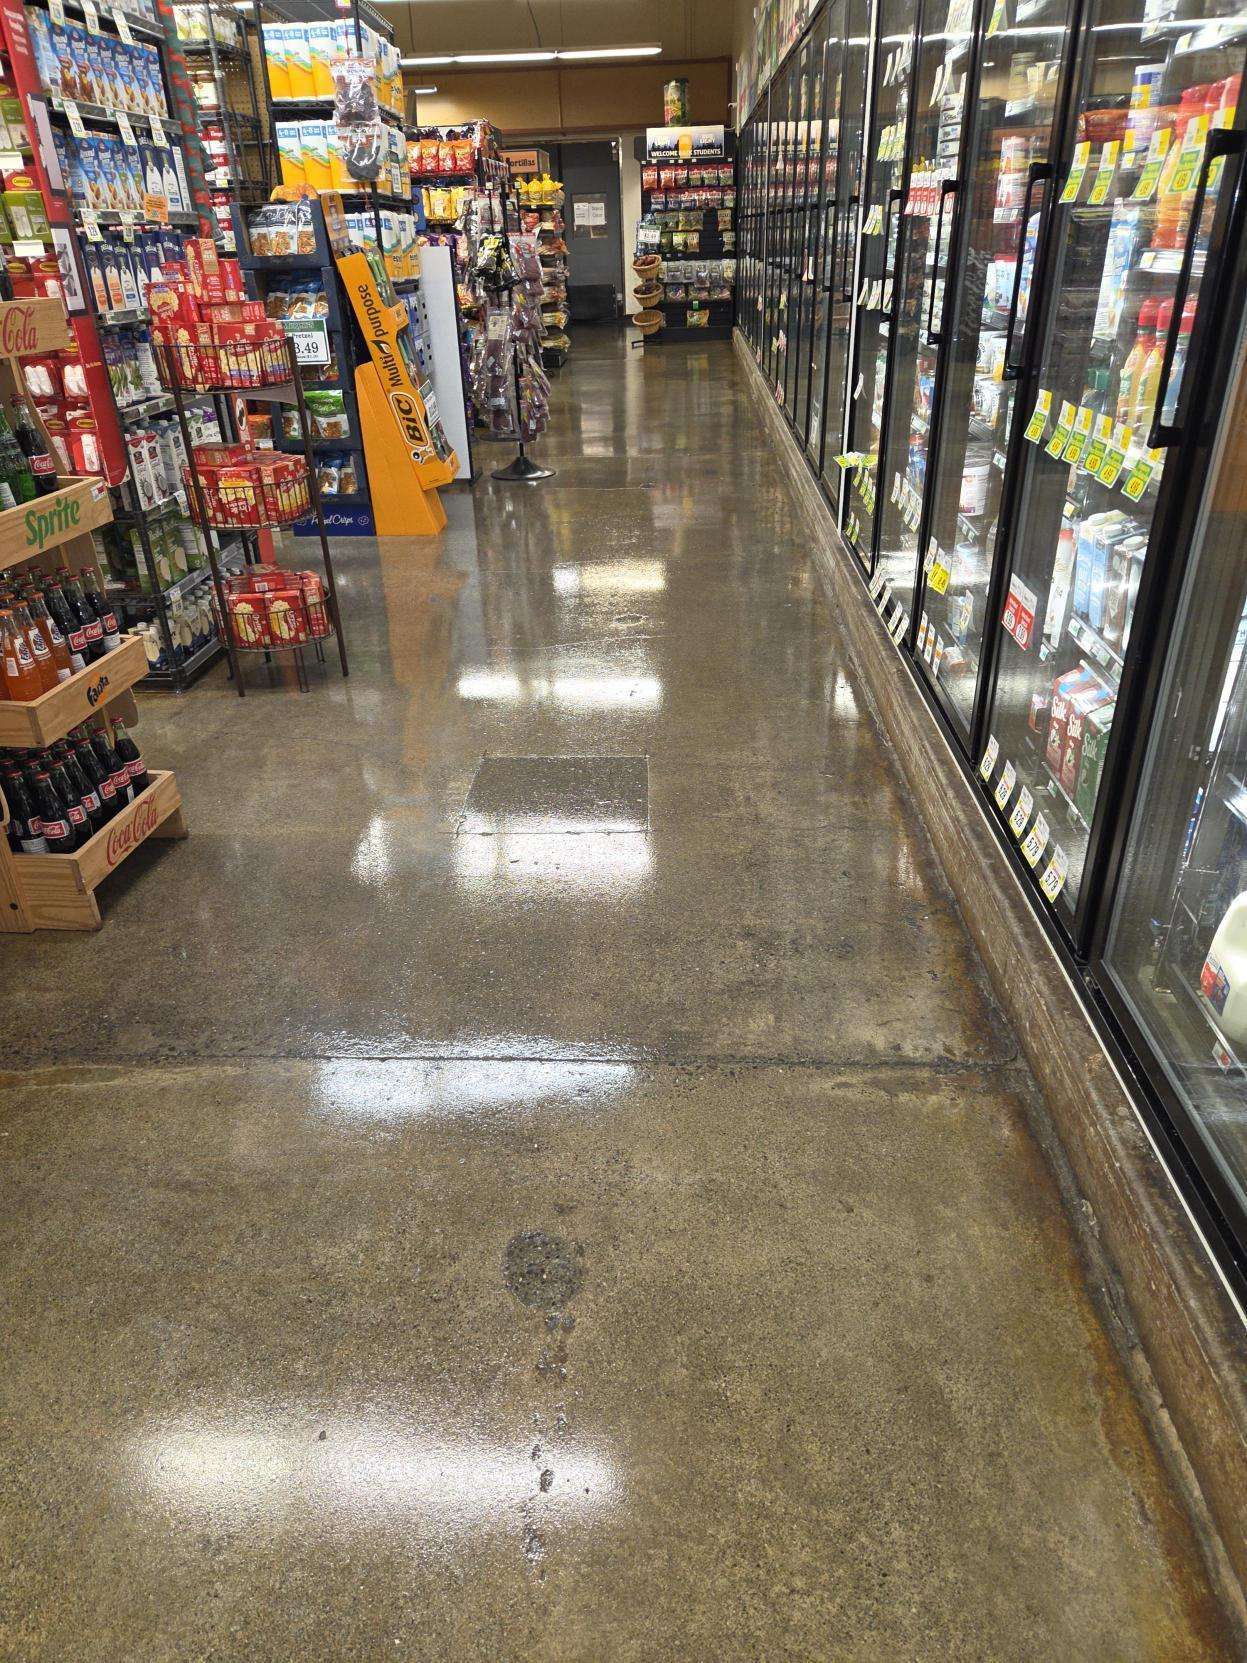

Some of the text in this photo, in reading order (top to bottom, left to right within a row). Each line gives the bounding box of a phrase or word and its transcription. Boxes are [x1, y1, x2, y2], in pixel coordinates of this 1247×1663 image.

[651, 149, 678, 157] WELCOME
[693, 148, 721, 156] STUDENTS
[358, 283, 389, 338] purpose
[3, 306, 39, 353] Cola
[379, 356, 404, 388] Multi
[24, 496, 81, 549] Sprite
[1051, 695, 1067, 722] Silk
[1067, 713, 1082, 740] Silk
